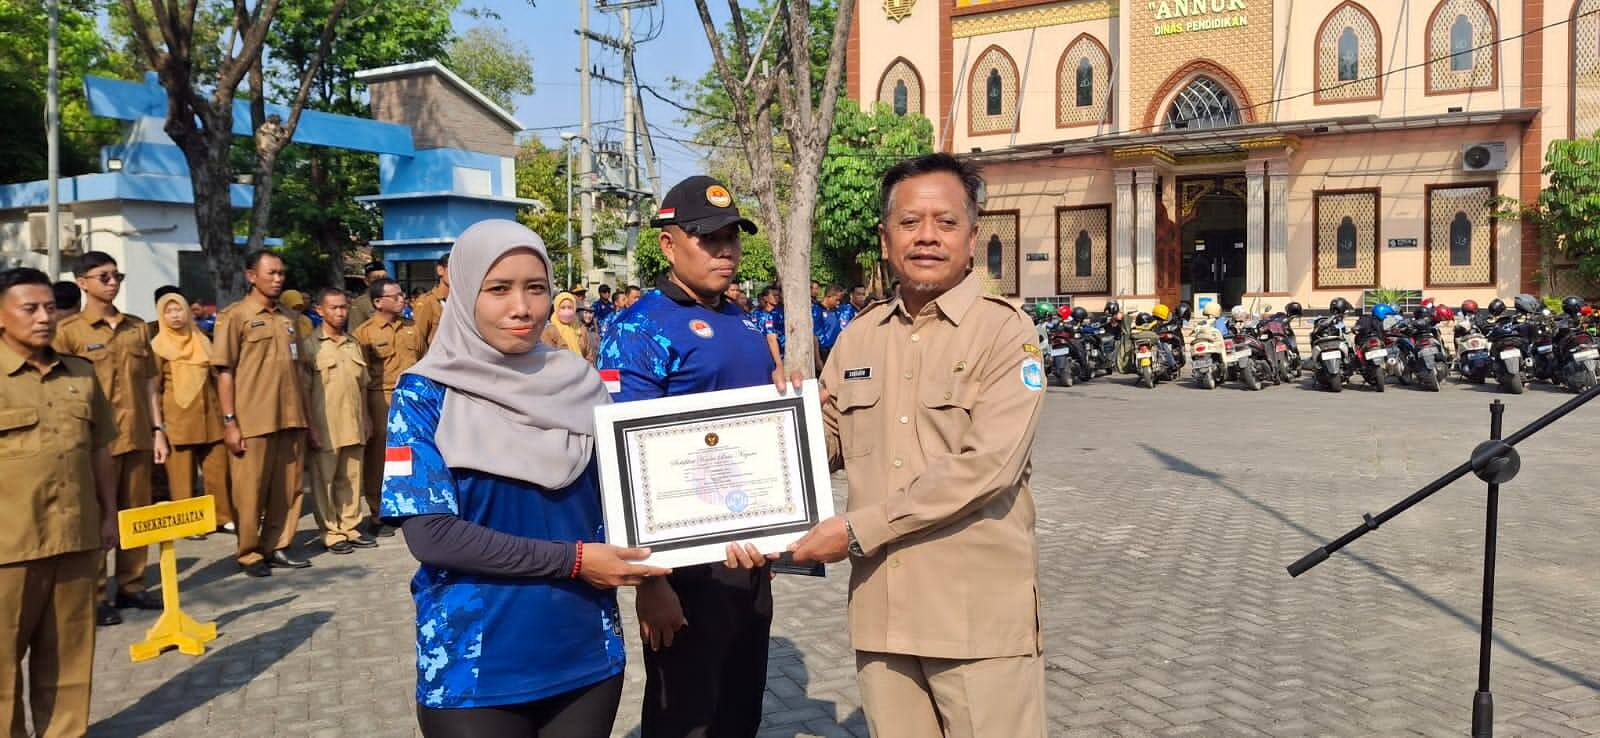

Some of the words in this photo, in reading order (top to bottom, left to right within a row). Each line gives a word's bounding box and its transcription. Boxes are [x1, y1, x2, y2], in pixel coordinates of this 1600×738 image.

[1155, 23, 1183, 36] DINAS
[1186, 15, 1247, 31] PENDIDIKAN
[133, 511, 204, 533] KESEKRETARIATAN
